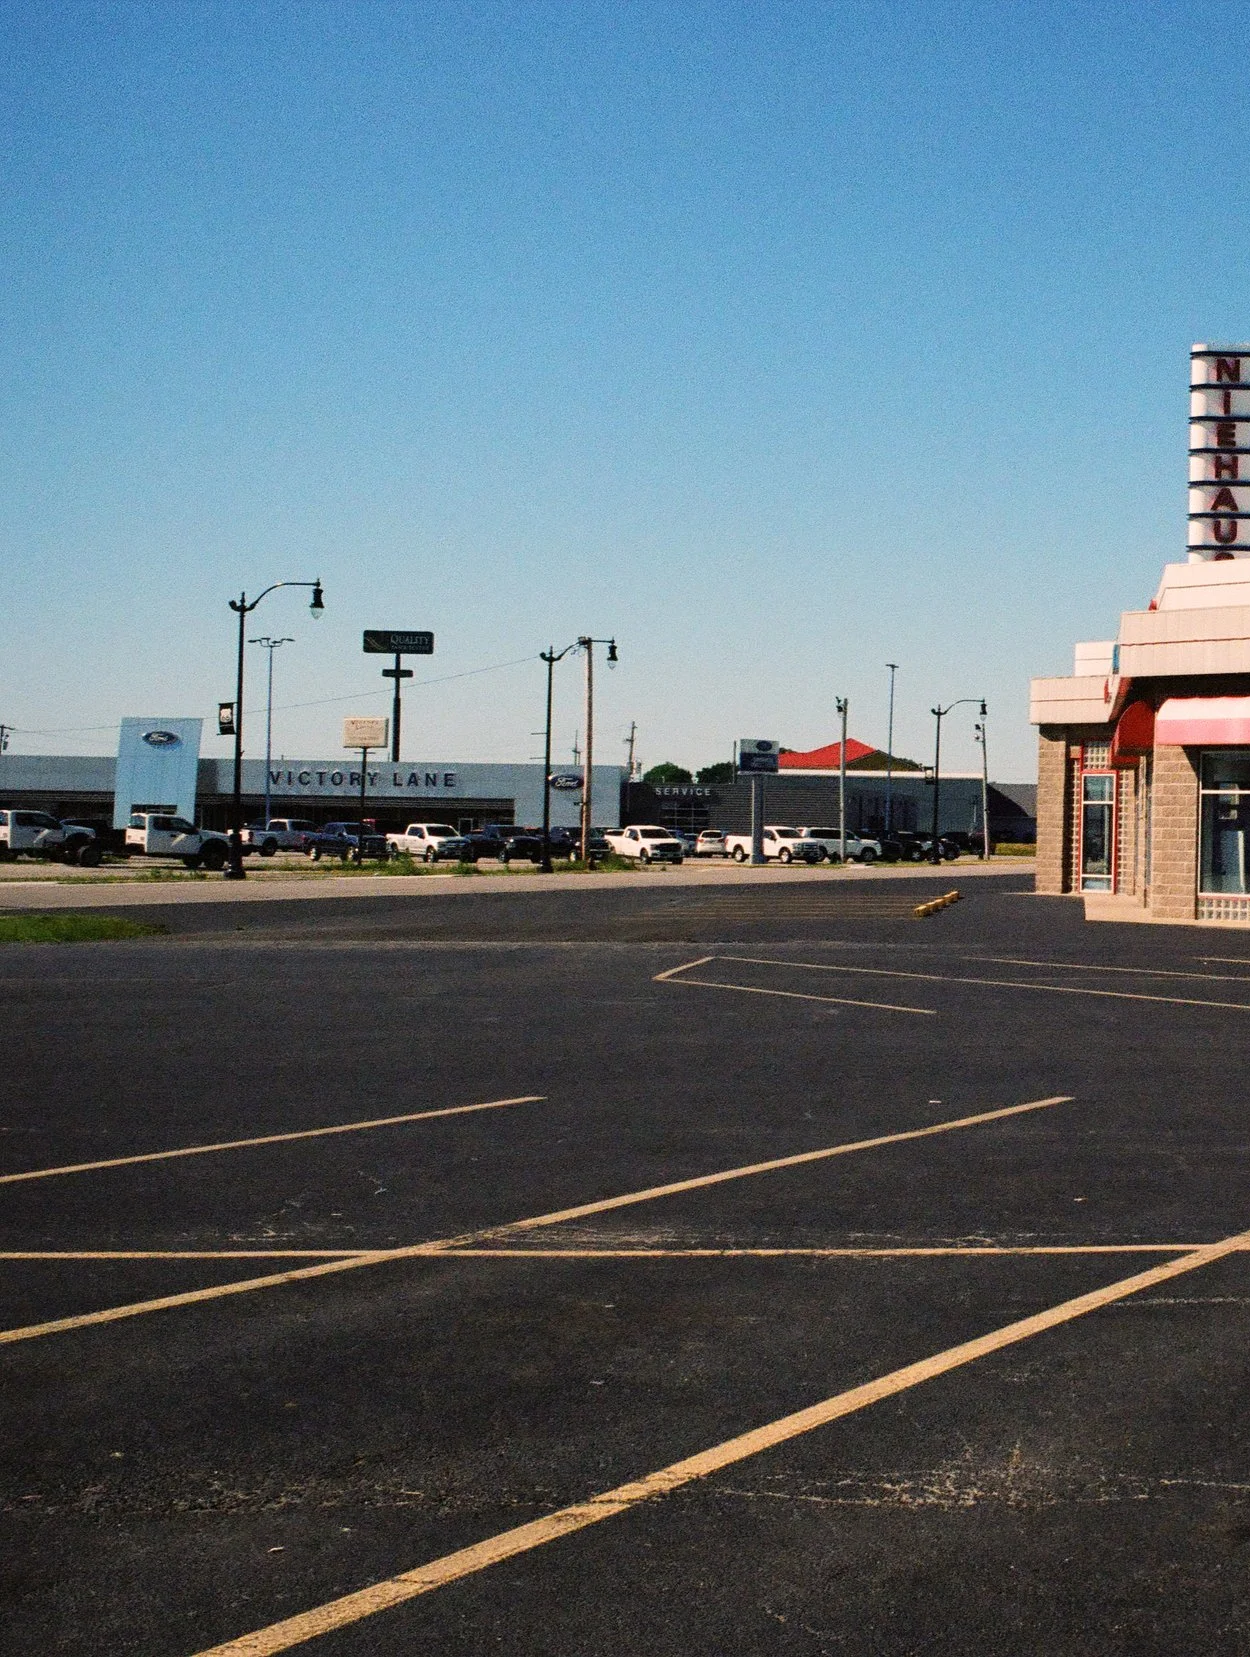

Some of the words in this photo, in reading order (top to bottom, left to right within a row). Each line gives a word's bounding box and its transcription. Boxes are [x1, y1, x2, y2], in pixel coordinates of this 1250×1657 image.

[391, 634, 431, 646] QUALITY
[269, 770, 378, 787] VICTORY
[393, 771, 457, 788] LANE
[555, 776, 579, 788] Ford
[655, 787, 711, 796] SERVICE
